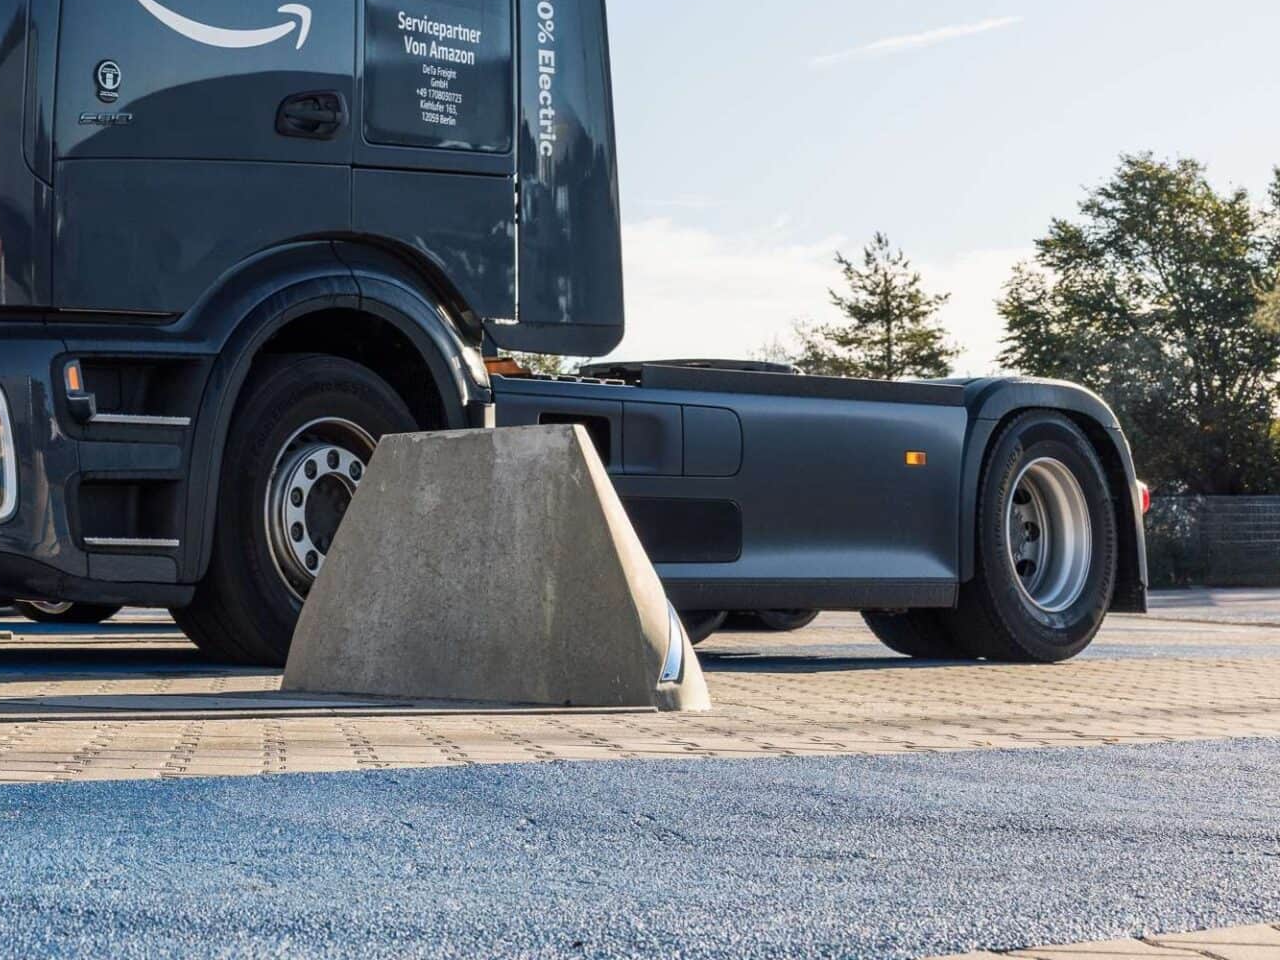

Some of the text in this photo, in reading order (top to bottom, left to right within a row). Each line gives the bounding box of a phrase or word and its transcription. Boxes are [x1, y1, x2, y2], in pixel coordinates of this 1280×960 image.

[397, 10, 481, 44] Servicepartner
[403, 34, 475, 66] Von Amazon
[430, 77, 448, 89] GmbH
[537, 48, 556, 158] Electric
[439, 114, 457, 126] Berlin
